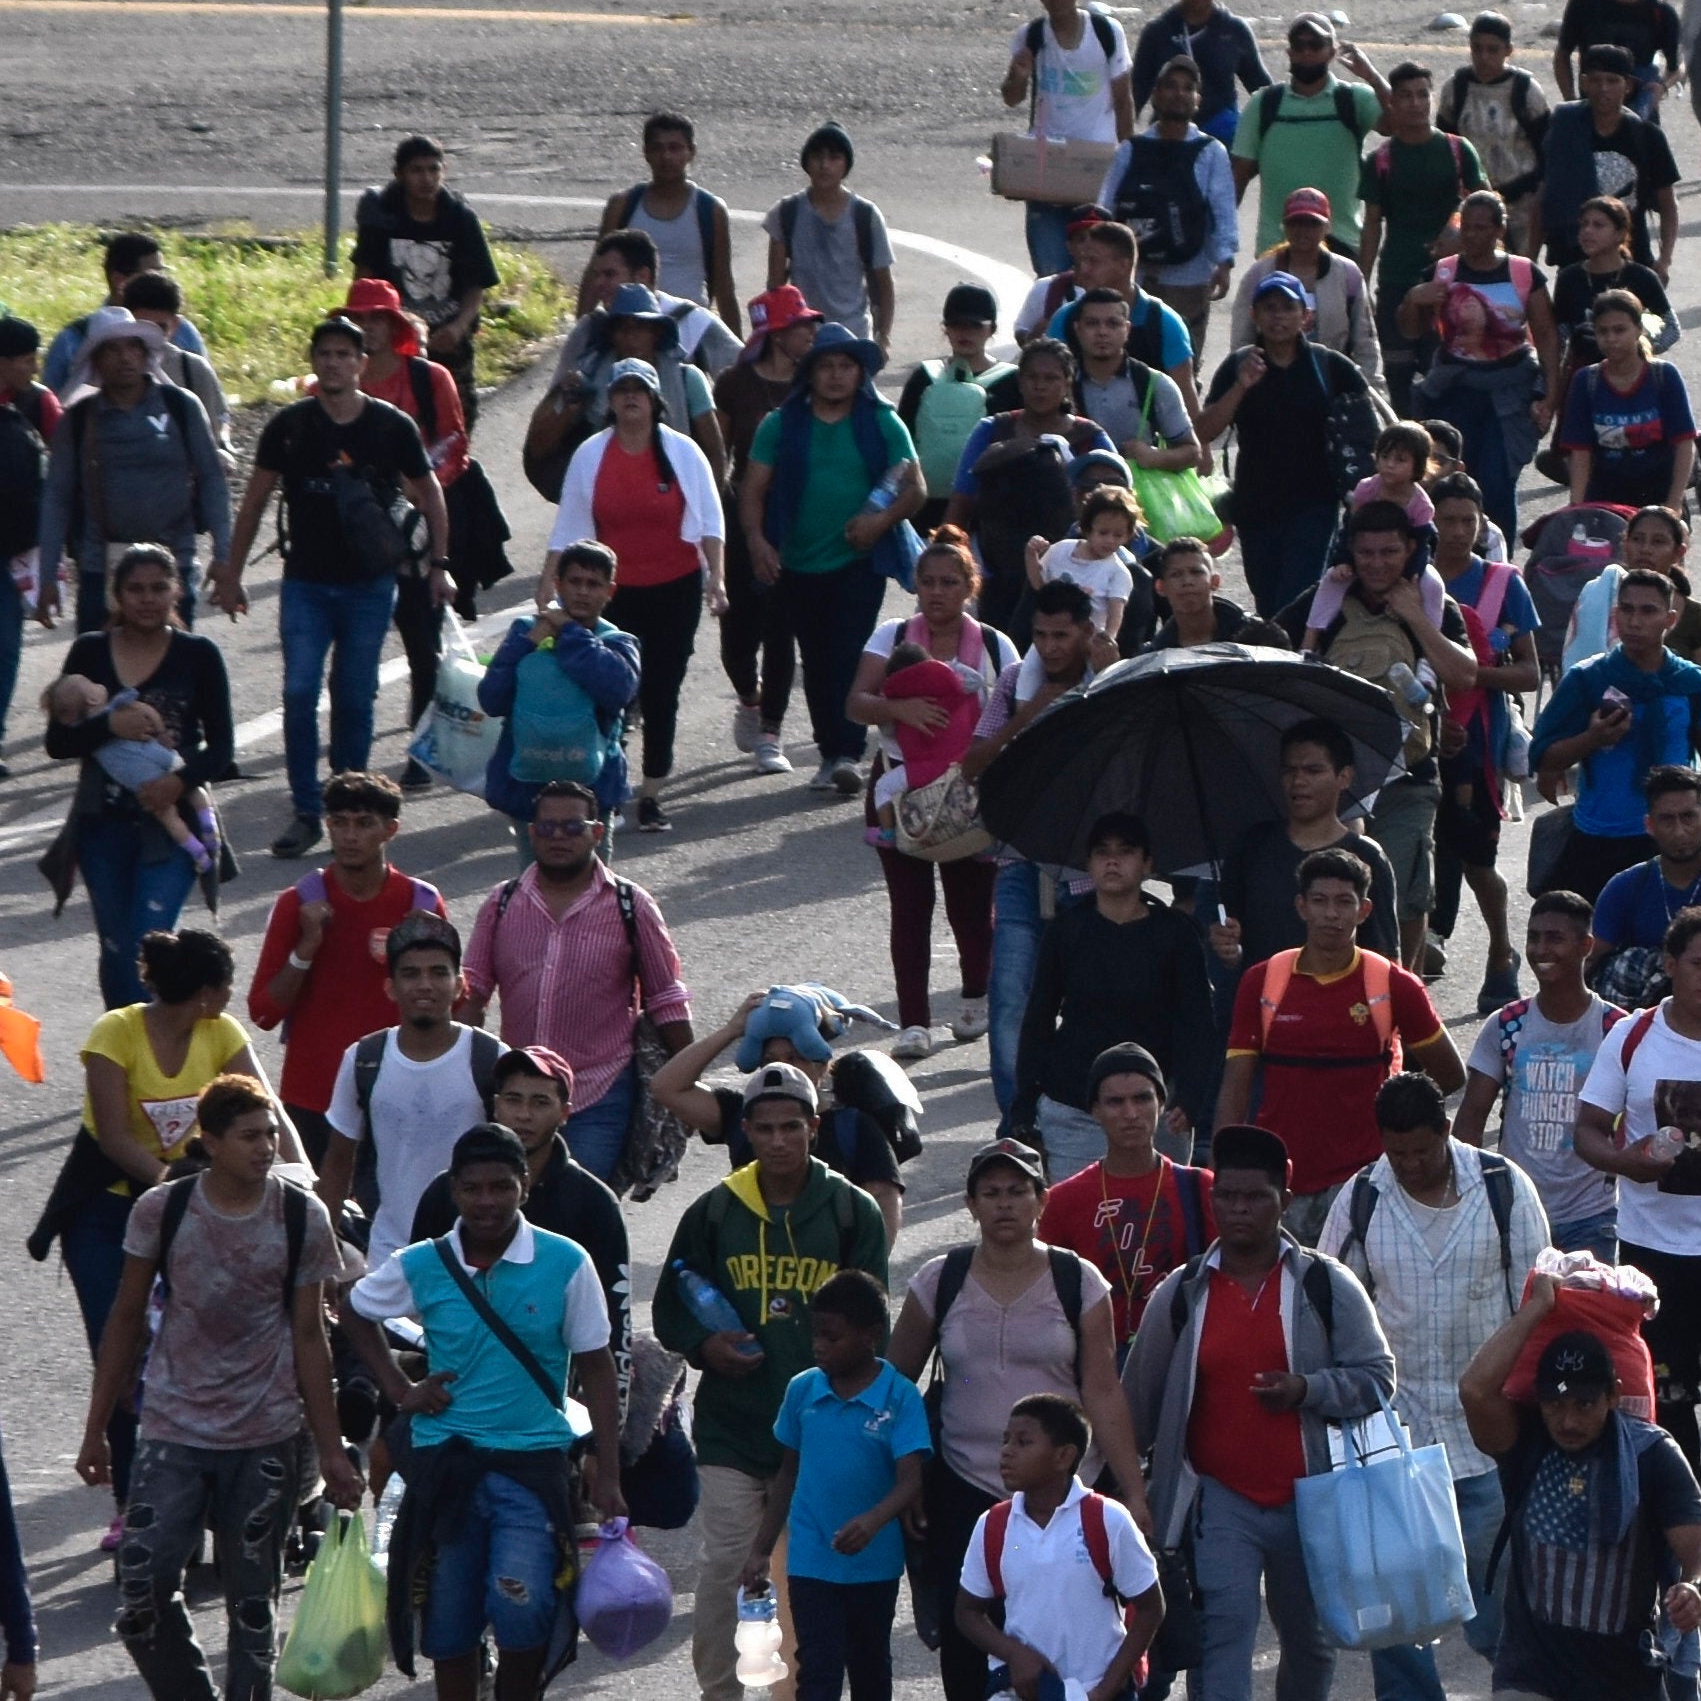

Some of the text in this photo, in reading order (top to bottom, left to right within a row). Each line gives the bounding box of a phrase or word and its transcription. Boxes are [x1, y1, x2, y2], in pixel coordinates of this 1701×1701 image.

[1594, 408, 1660, 427] TOMMY
[1525, 1061, 1576, 1094] WATCH
[149, 1102, 198, 1118] GUES
[1520, 1092, 1576, 1124] HUNGER
[1528, 1121, 1568, 1153] STOP
[726, 1253, 839, 1291] OREGON
